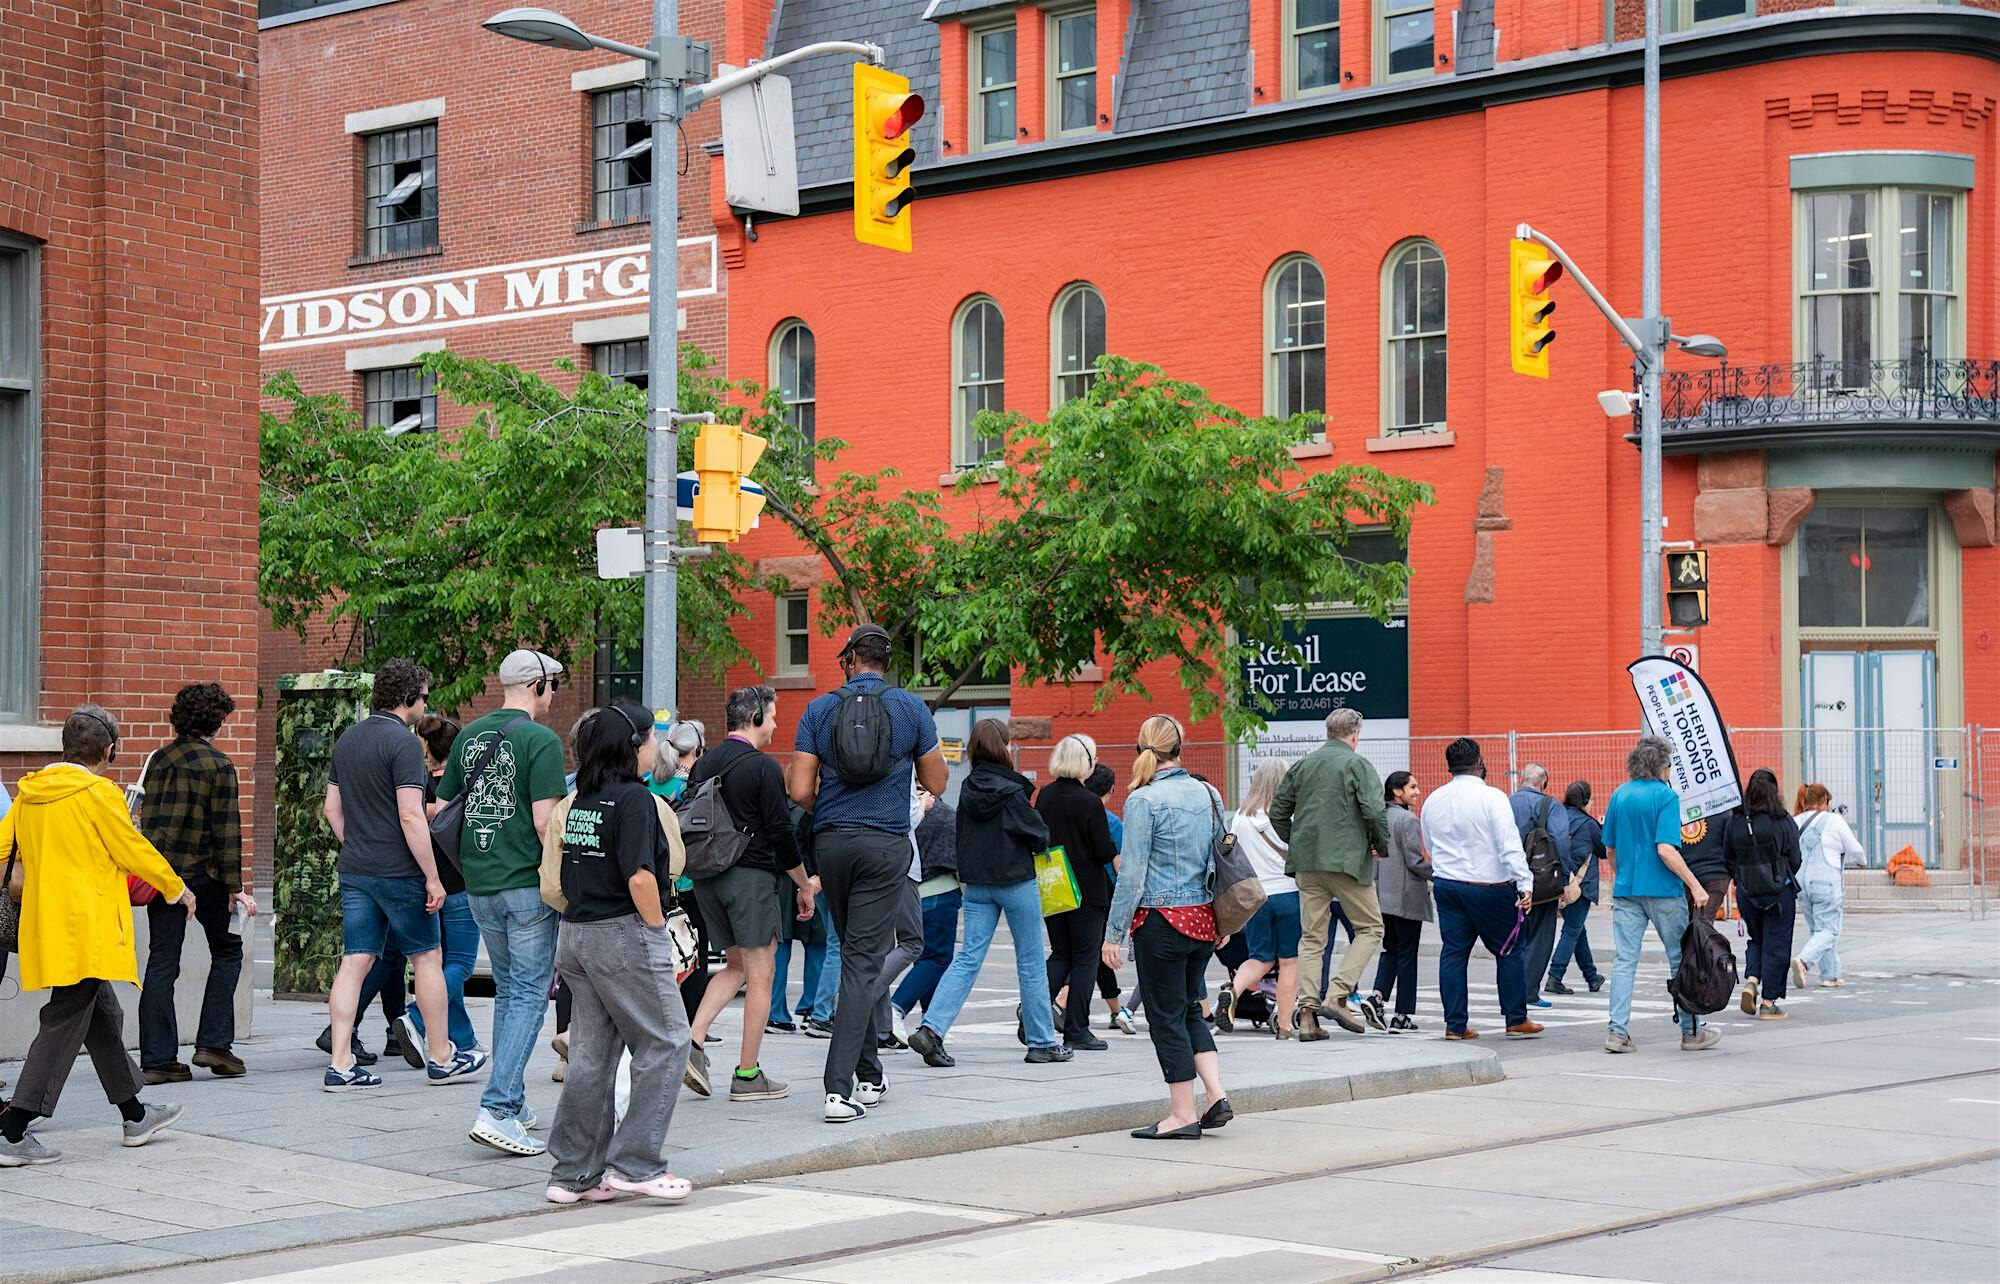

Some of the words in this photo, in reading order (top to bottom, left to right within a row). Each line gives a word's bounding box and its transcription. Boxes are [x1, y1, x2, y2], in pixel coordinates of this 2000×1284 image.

[1247, 667, 1289, 694] For
[1294, 666, 1366, 693] Lease
[1274, 699, 1286, 710] SF
[1288, 700, 1298, 709] to
[1300, 698, 1331, 710] 20,461
[1332, 697, 1346, 709] SF
[1673, 707, 1707, 784] TORONTO
[1686, 702, 1722, 780] HERITAGE
[567, 820, 595, 834] STUDIOS
